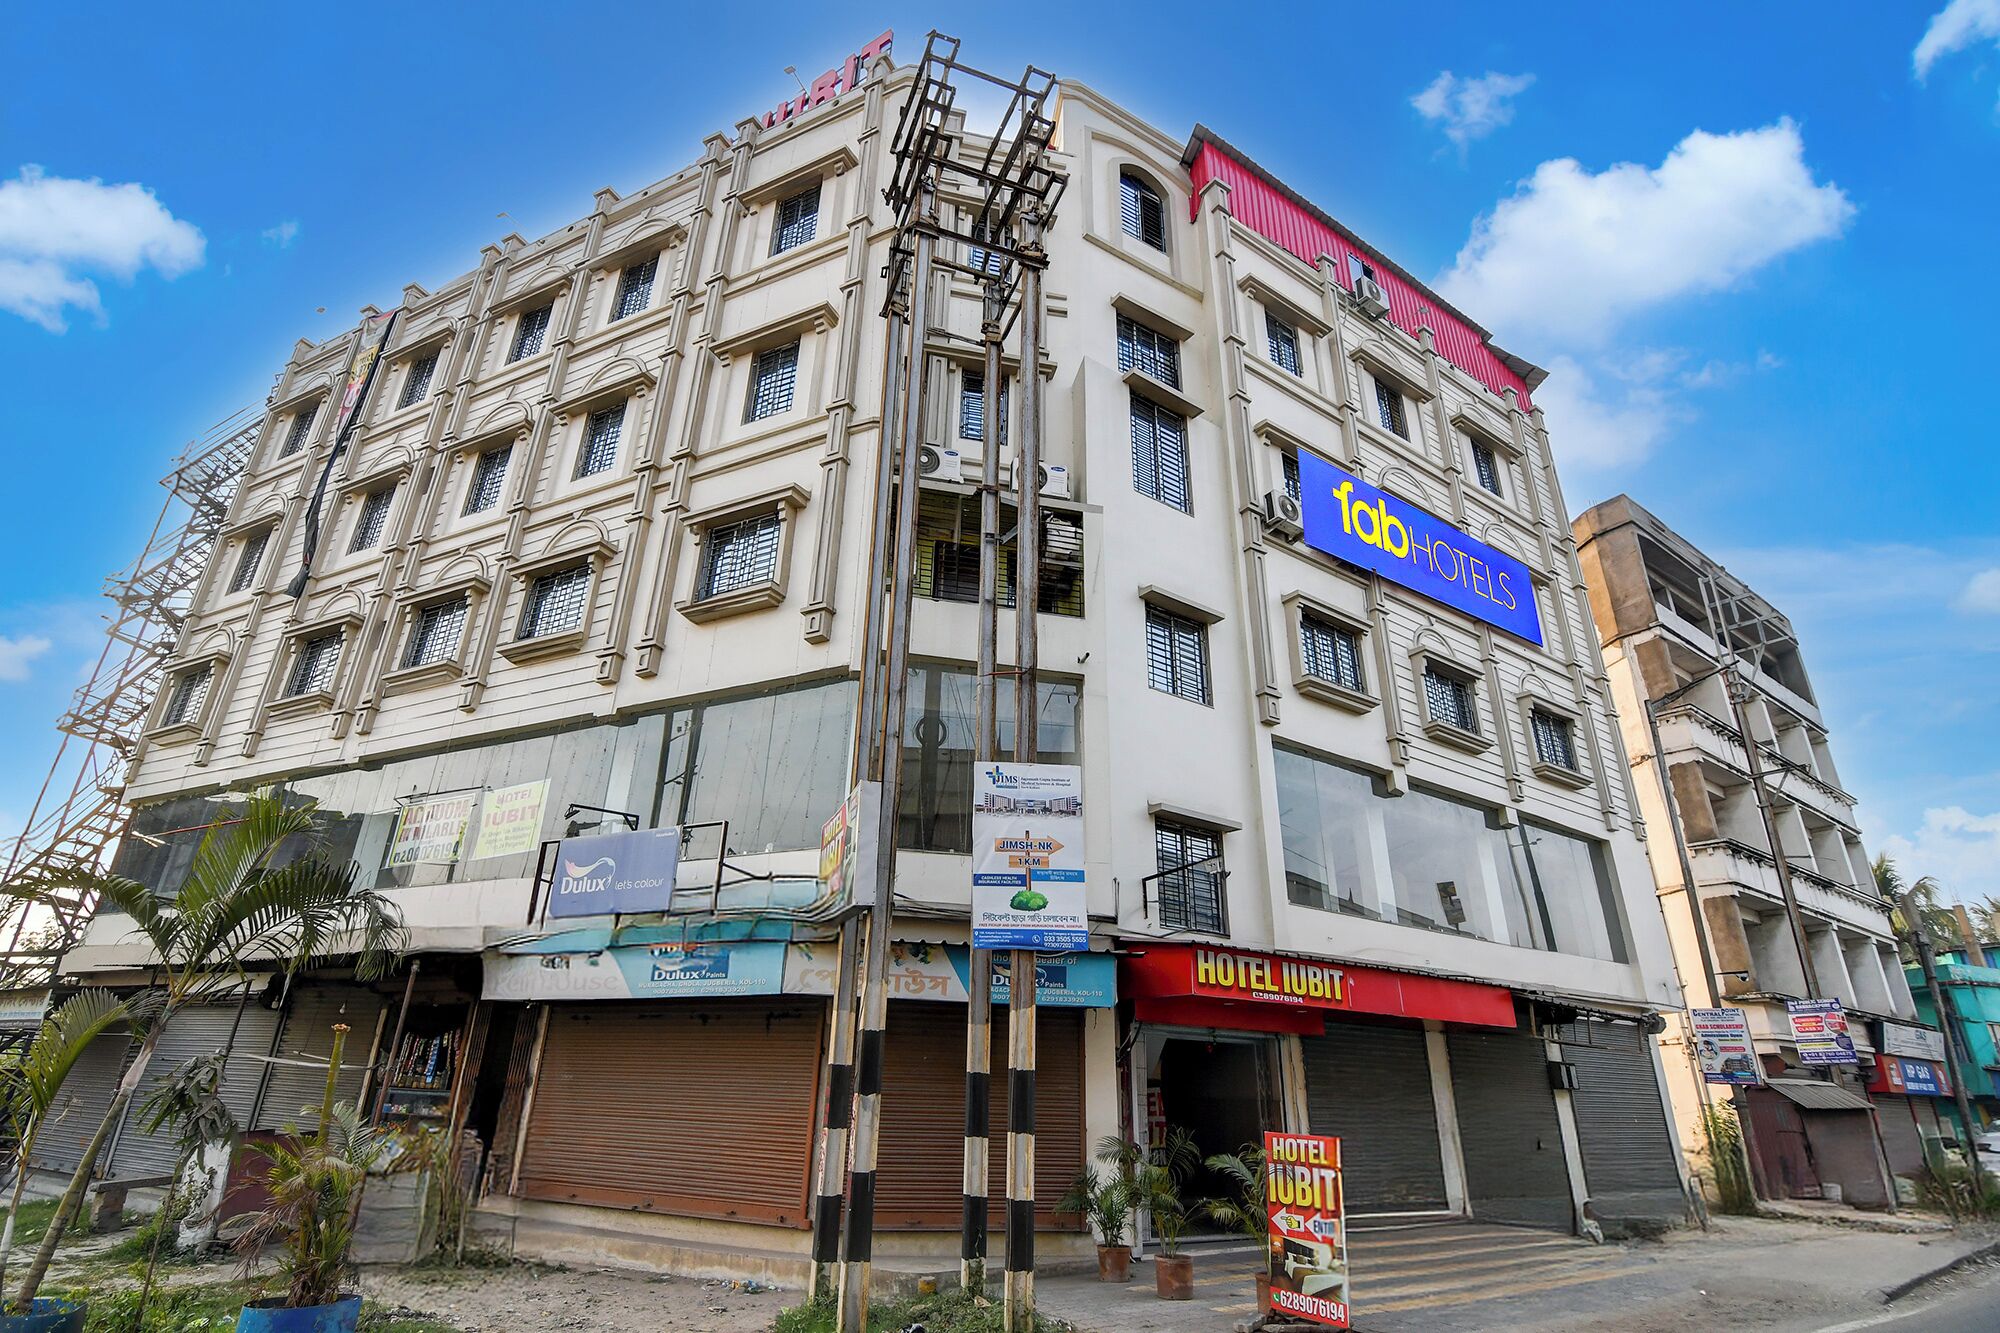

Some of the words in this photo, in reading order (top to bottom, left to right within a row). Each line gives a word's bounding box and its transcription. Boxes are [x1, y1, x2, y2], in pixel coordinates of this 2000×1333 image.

[995, 775, 1018, 784] JIMS
[483, 804, 540, 829] IUBIT
[560, 876, 605, 895] Dulux
[634, 877, 665, 889] colour
[653, 969, 700, 981] Dulux
[1196, 949, 1279, 992] HOTEL
[1281, 961, 1344, 1001] IUBIT
[1692, 1009, 1721, 1017] CENTRAL
[1720, 1008, 1740, 1016] POINT
[1916, 1064, 1930, 1080] GAS
[1272, 1137, 1330, 1165] HOTEL
[1268, 1162, 1337, 1211] IUBIT
[1279, 1289, 1346, 1323] 6289076194
